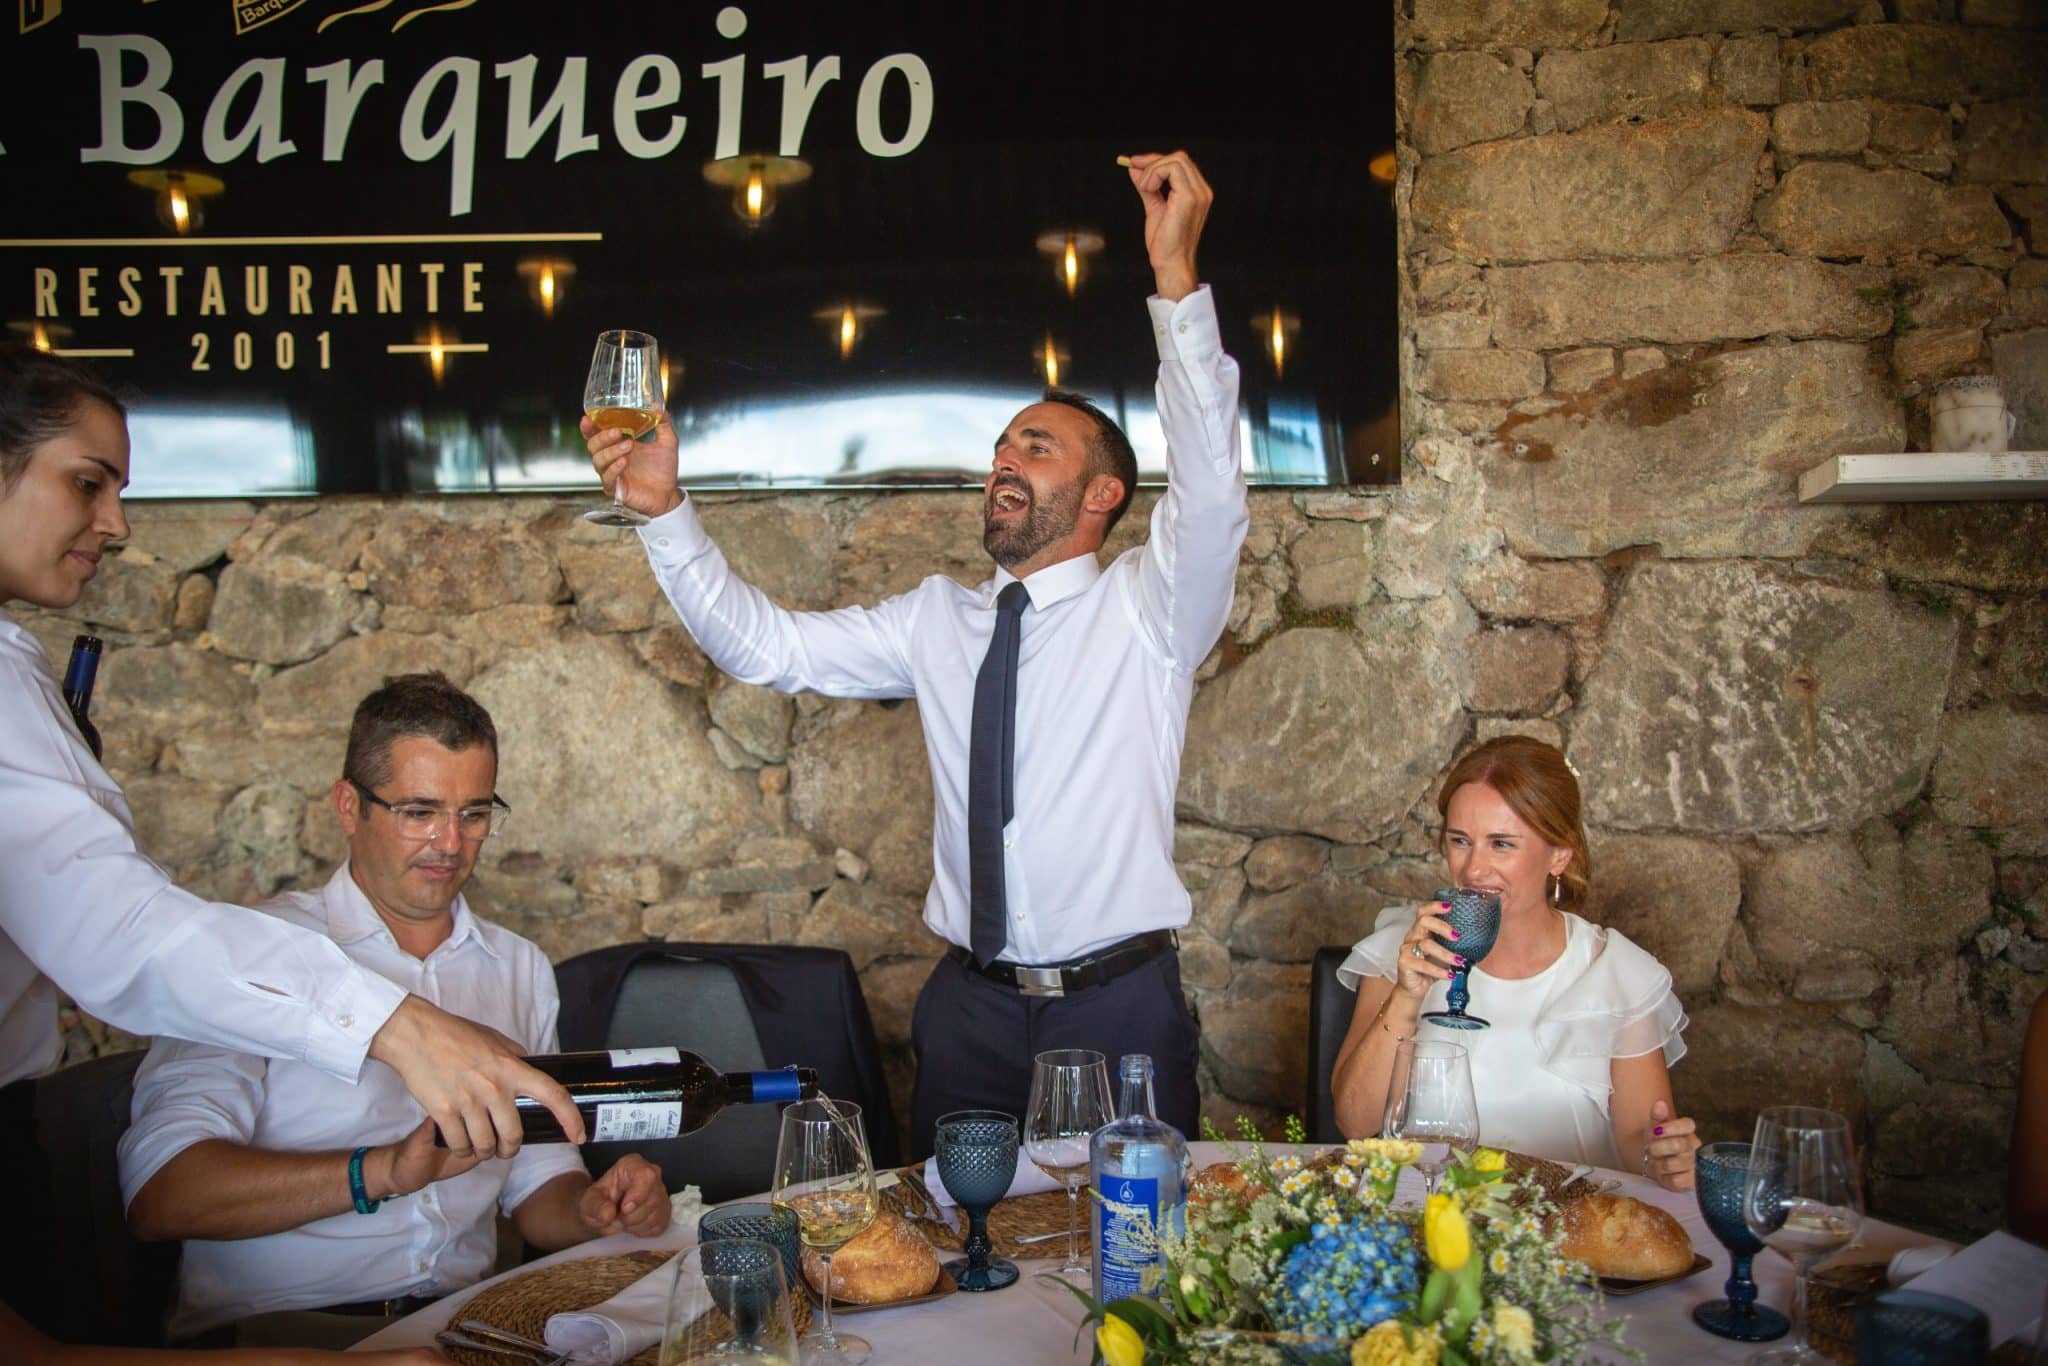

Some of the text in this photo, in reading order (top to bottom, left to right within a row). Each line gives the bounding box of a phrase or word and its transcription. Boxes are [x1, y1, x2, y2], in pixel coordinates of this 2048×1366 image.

[240, 0, 289, 23] Barq
[79, 7, 934, 219] Barqueiro
[35, 263, 484, 317] RESTAURANTE
[191, 331, 332, 371] 2001
